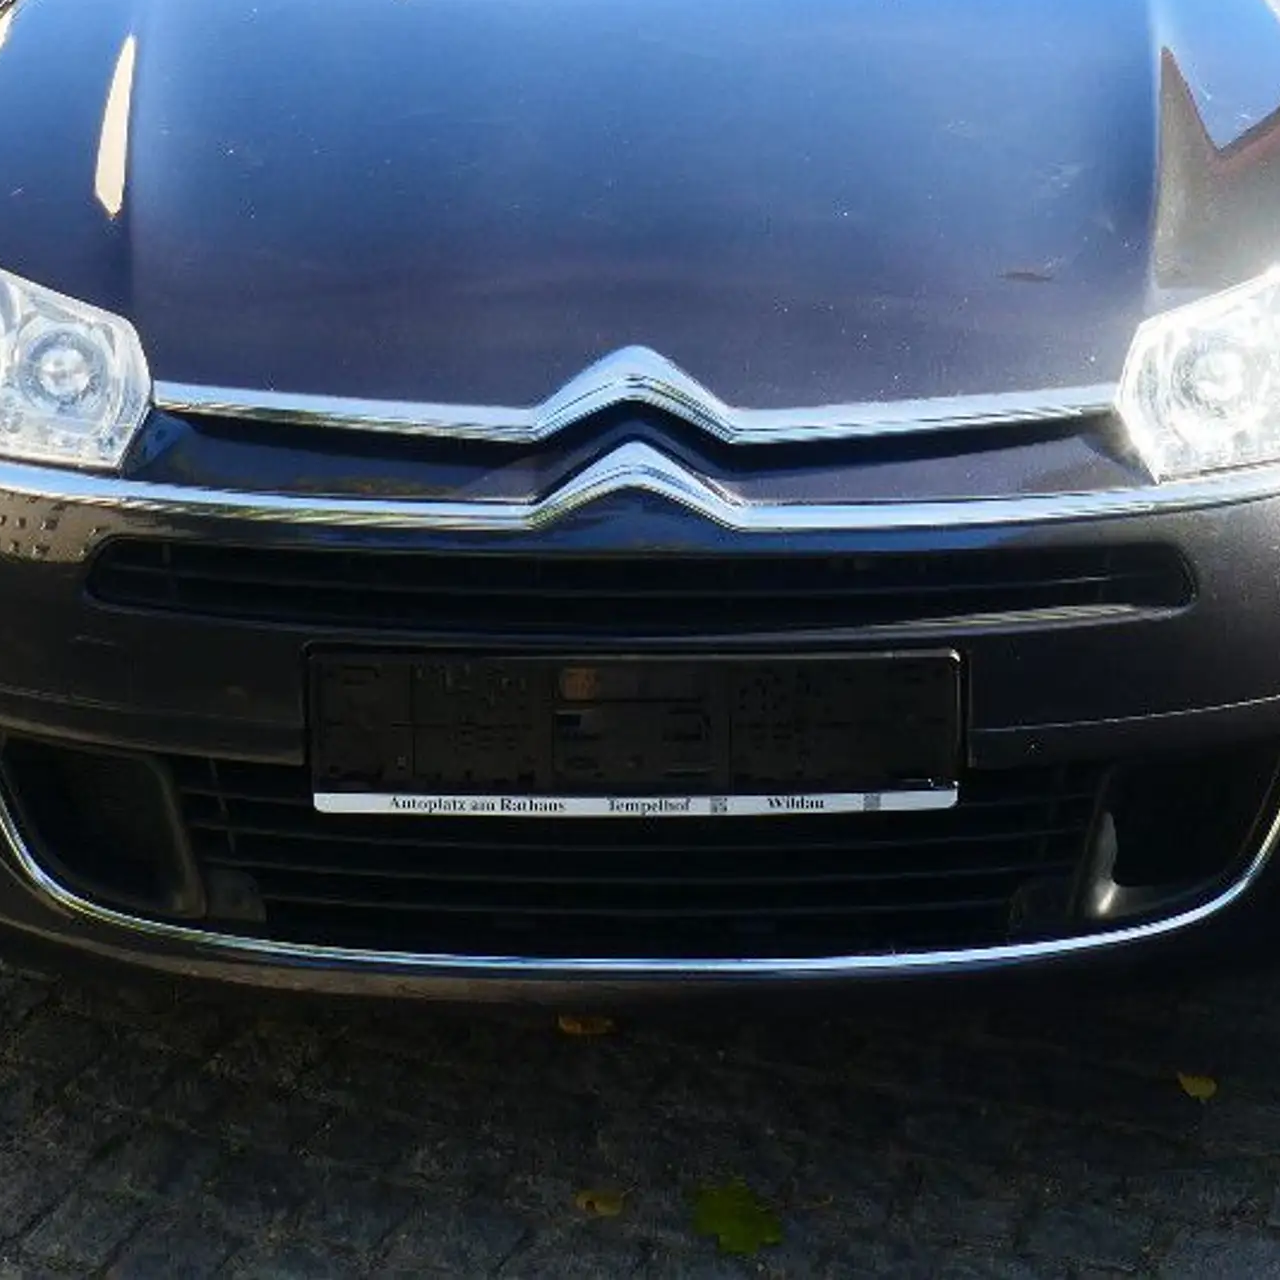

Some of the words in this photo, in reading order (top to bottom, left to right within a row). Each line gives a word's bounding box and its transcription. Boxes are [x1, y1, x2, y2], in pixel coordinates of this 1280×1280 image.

[390, 796, 467, 813] Autoplatz
[471, 799, 495, 812] am
[500, 797, 567, 813] Rathaus
[607, 797, 691, 815] Tempelhof
[767, 797, 825, 810] Wildau
